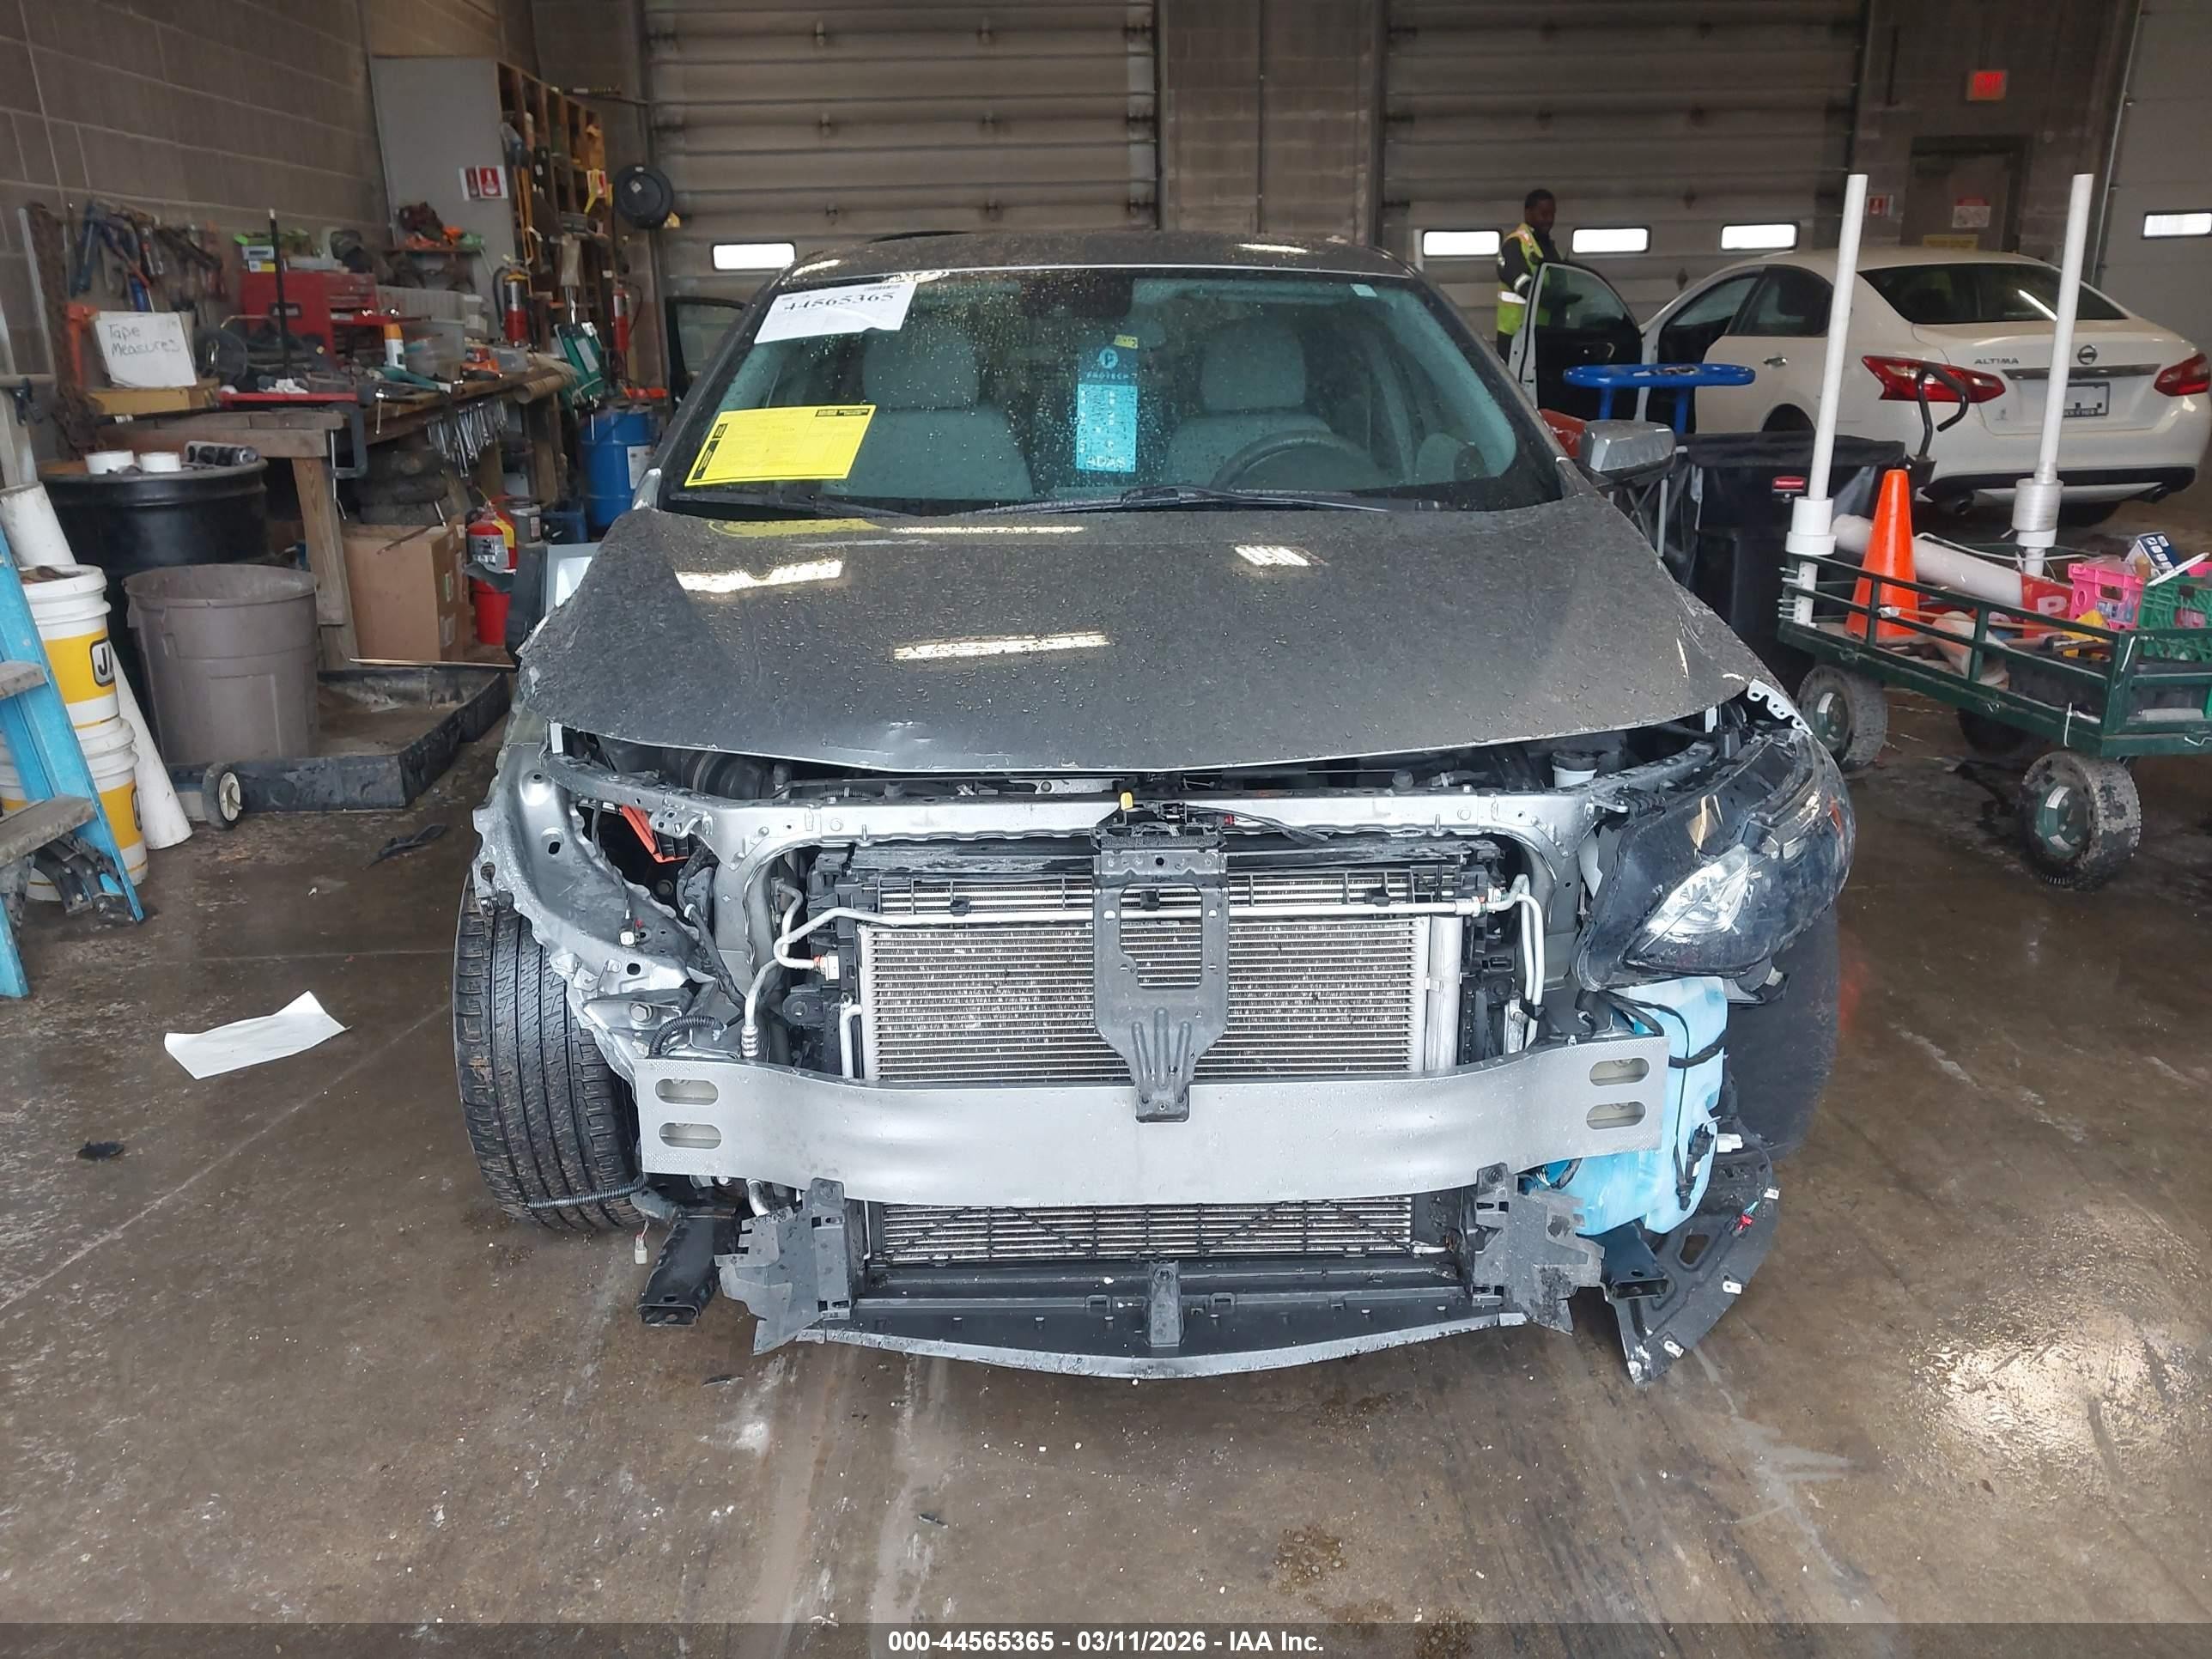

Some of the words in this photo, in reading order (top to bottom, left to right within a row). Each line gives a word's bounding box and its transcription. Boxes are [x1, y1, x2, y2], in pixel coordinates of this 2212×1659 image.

[783, 293, 895, 312] 44565365
[108, 323, 141, 342] Tape
[111, 339, 180, 357] Measures
[1086, 455, 1127, 469] ADAS
